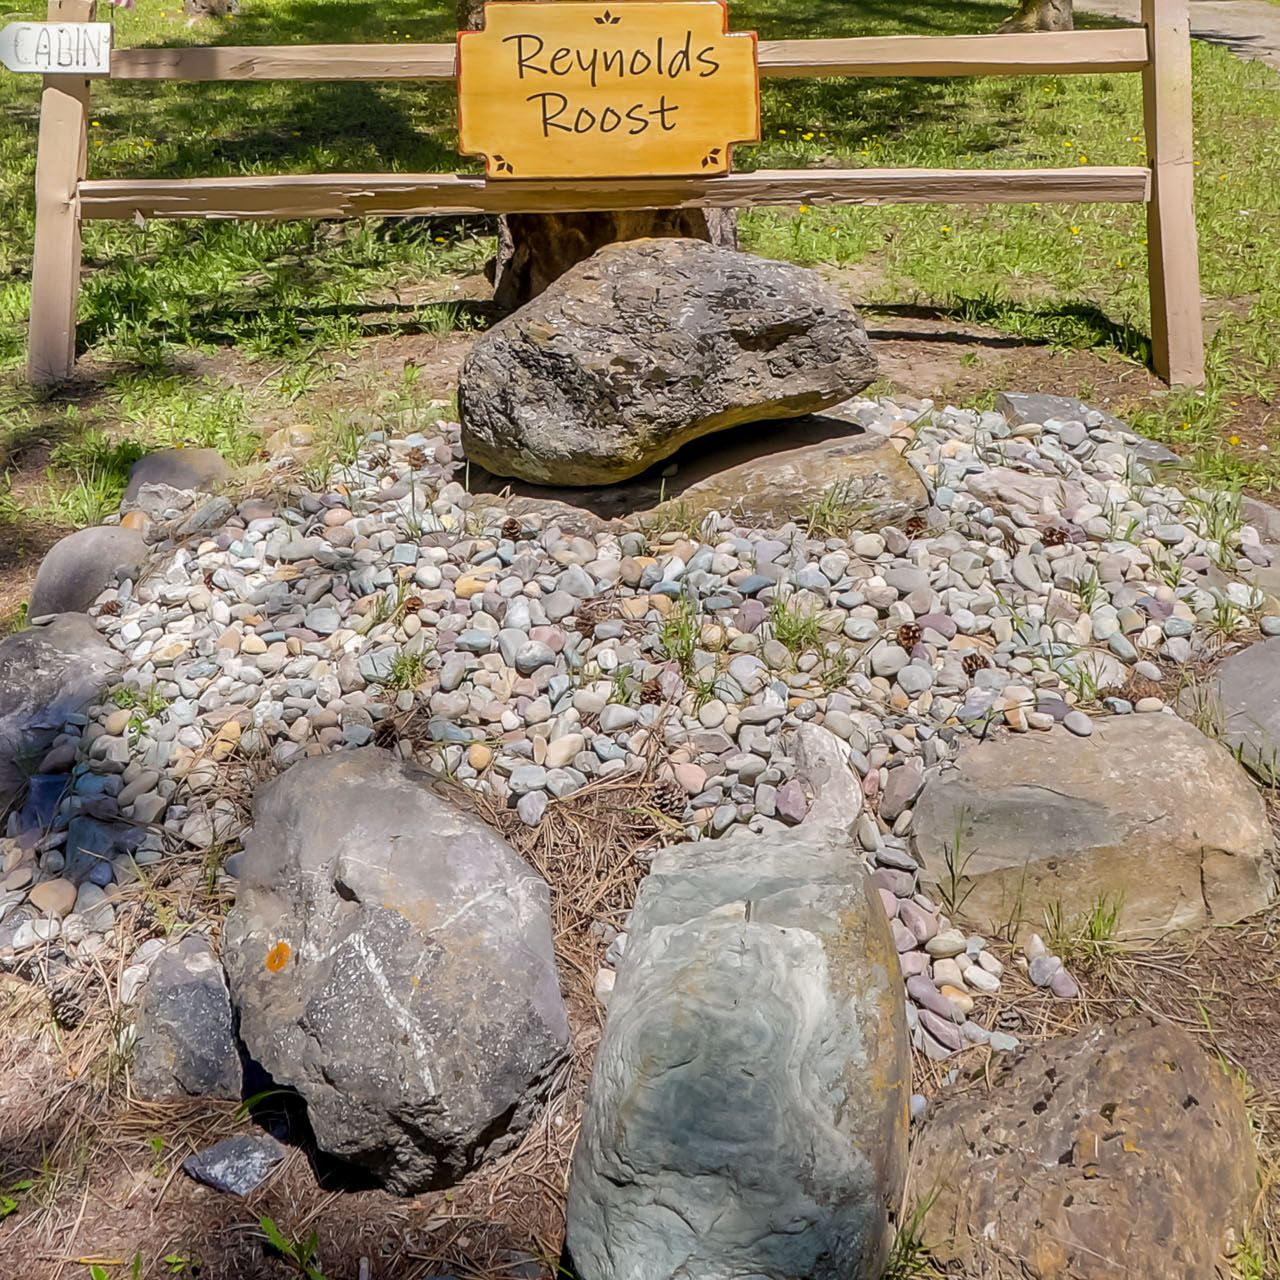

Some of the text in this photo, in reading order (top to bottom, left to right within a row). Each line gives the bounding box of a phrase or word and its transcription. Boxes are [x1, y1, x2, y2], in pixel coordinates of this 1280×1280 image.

[14, 26, 101, 67] CABIN
[501, 30, 720, 87] Reynolds
[526, 92, 679, 137] Roost
